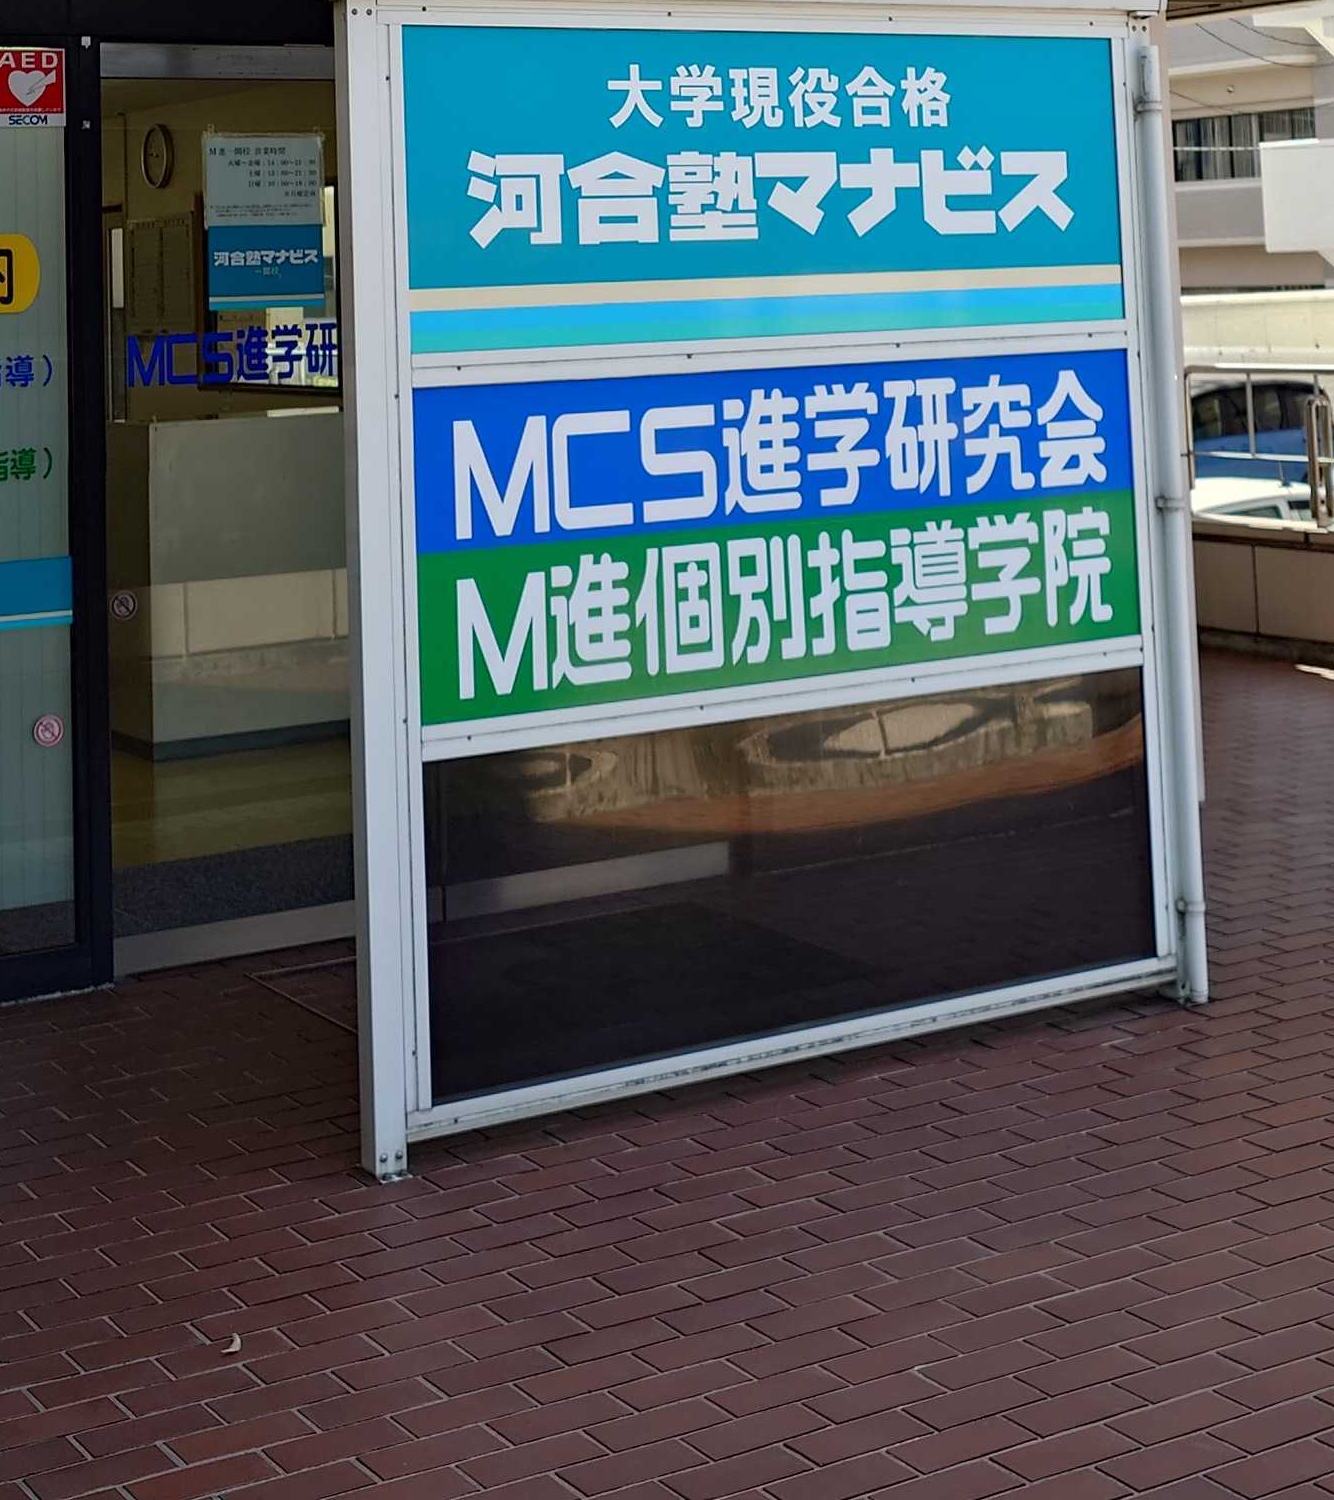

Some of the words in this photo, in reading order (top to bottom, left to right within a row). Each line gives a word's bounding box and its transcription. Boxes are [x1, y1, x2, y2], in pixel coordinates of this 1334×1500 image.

[9, 115, 48, 125] SECOM
[606, 64, 951, 129] 大学現役合格
[466, 145, 1074, 249] 河合塾マナビス
[452, 369, 1107, 541] MCS進学研究会
[456, 506, 1113, 700] M進個別指導学院
